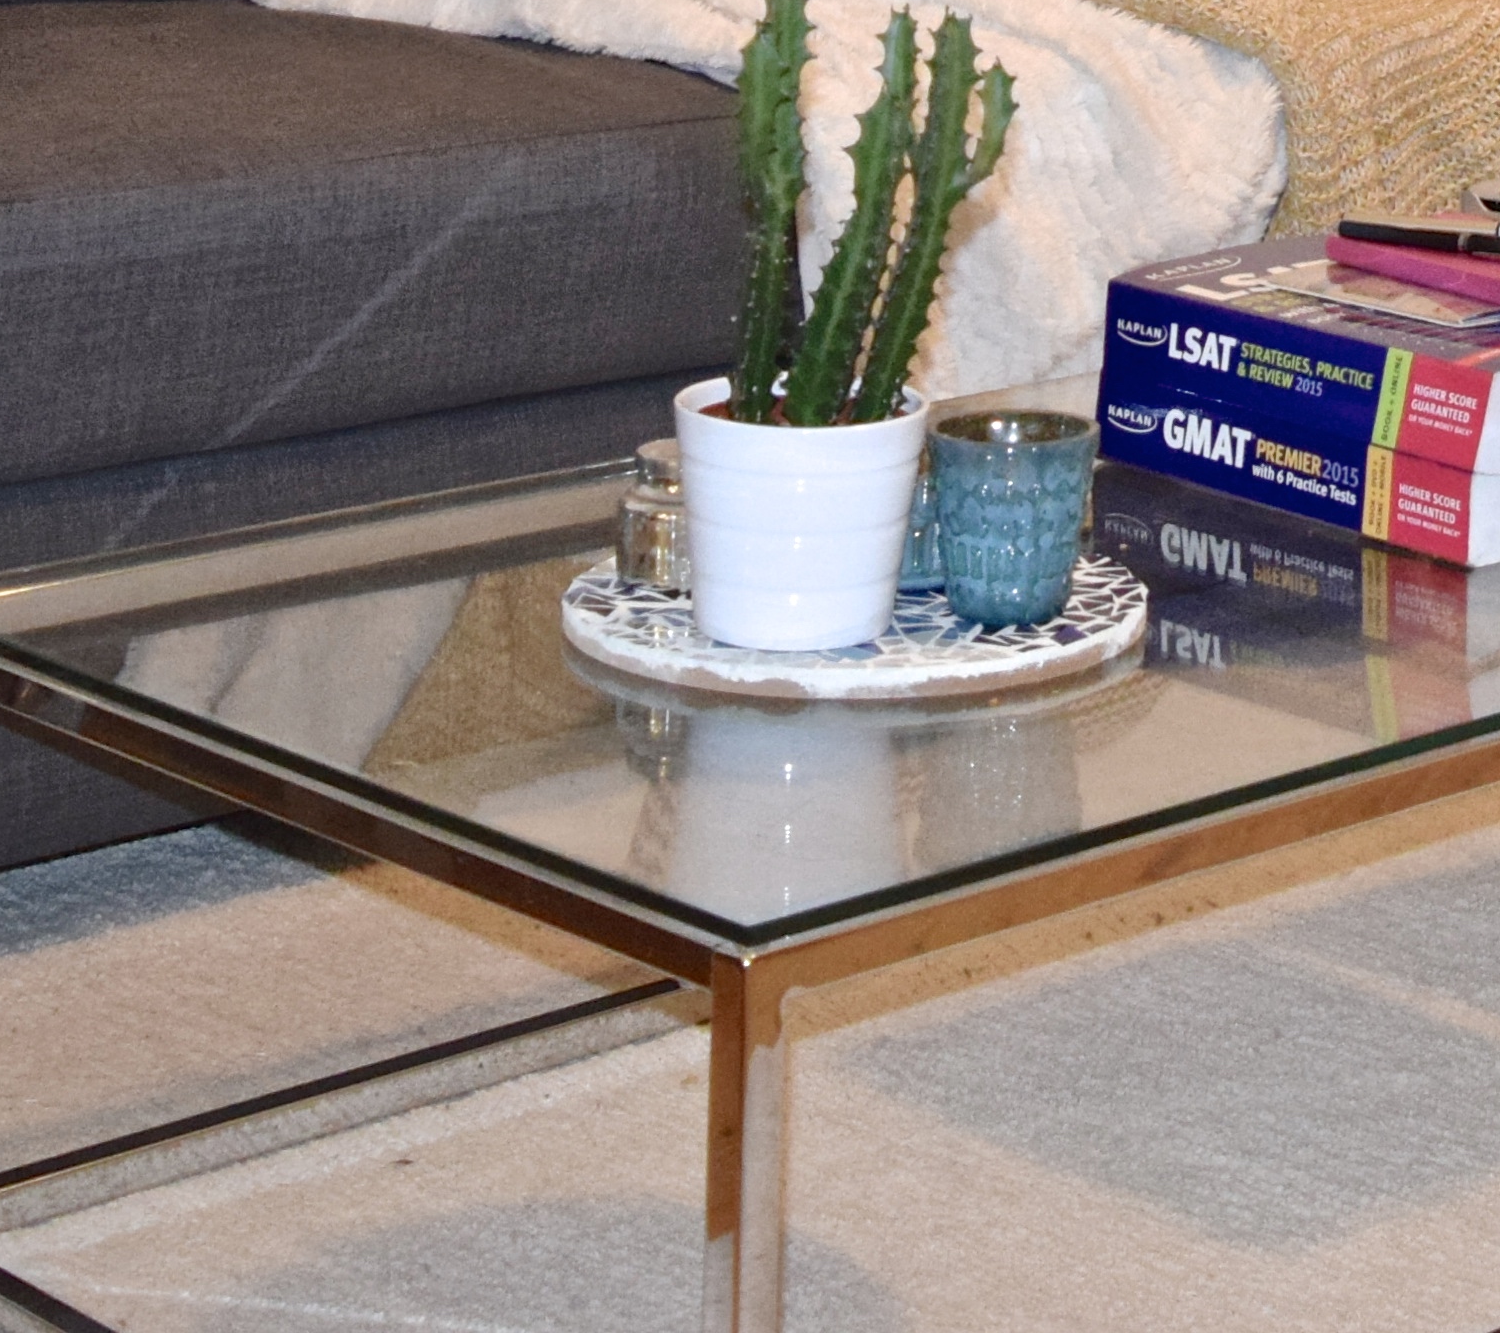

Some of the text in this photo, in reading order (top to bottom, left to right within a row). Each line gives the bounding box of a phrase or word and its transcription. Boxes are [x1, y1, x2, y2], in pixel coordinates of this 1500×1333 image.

[1116, 318, 1374, 390] KAPLAN LSAT STRATEGIES, PRACTICE
[1236, 361, 1323, 397] & REVIEW 2015
[1410, 398, 1470, 424] GUARANTEED
[1412, 383, 1478, 410] HIGHER SCORE
[1408, 413, 1417, 422] OR
[1417, 416, 1434, 427] YOUR
[1433, 420, 1454, 433] MONEY
[1107, 404, 1360, 488] KAPLAN GMAT PREMIER 2015
[1251, 463, 1357, 506] with 6 Practice Tests
[1398, 482, 1462, 511] HIGHER SCORE
[1397, 498, 1456, 525] GUARANTEED
